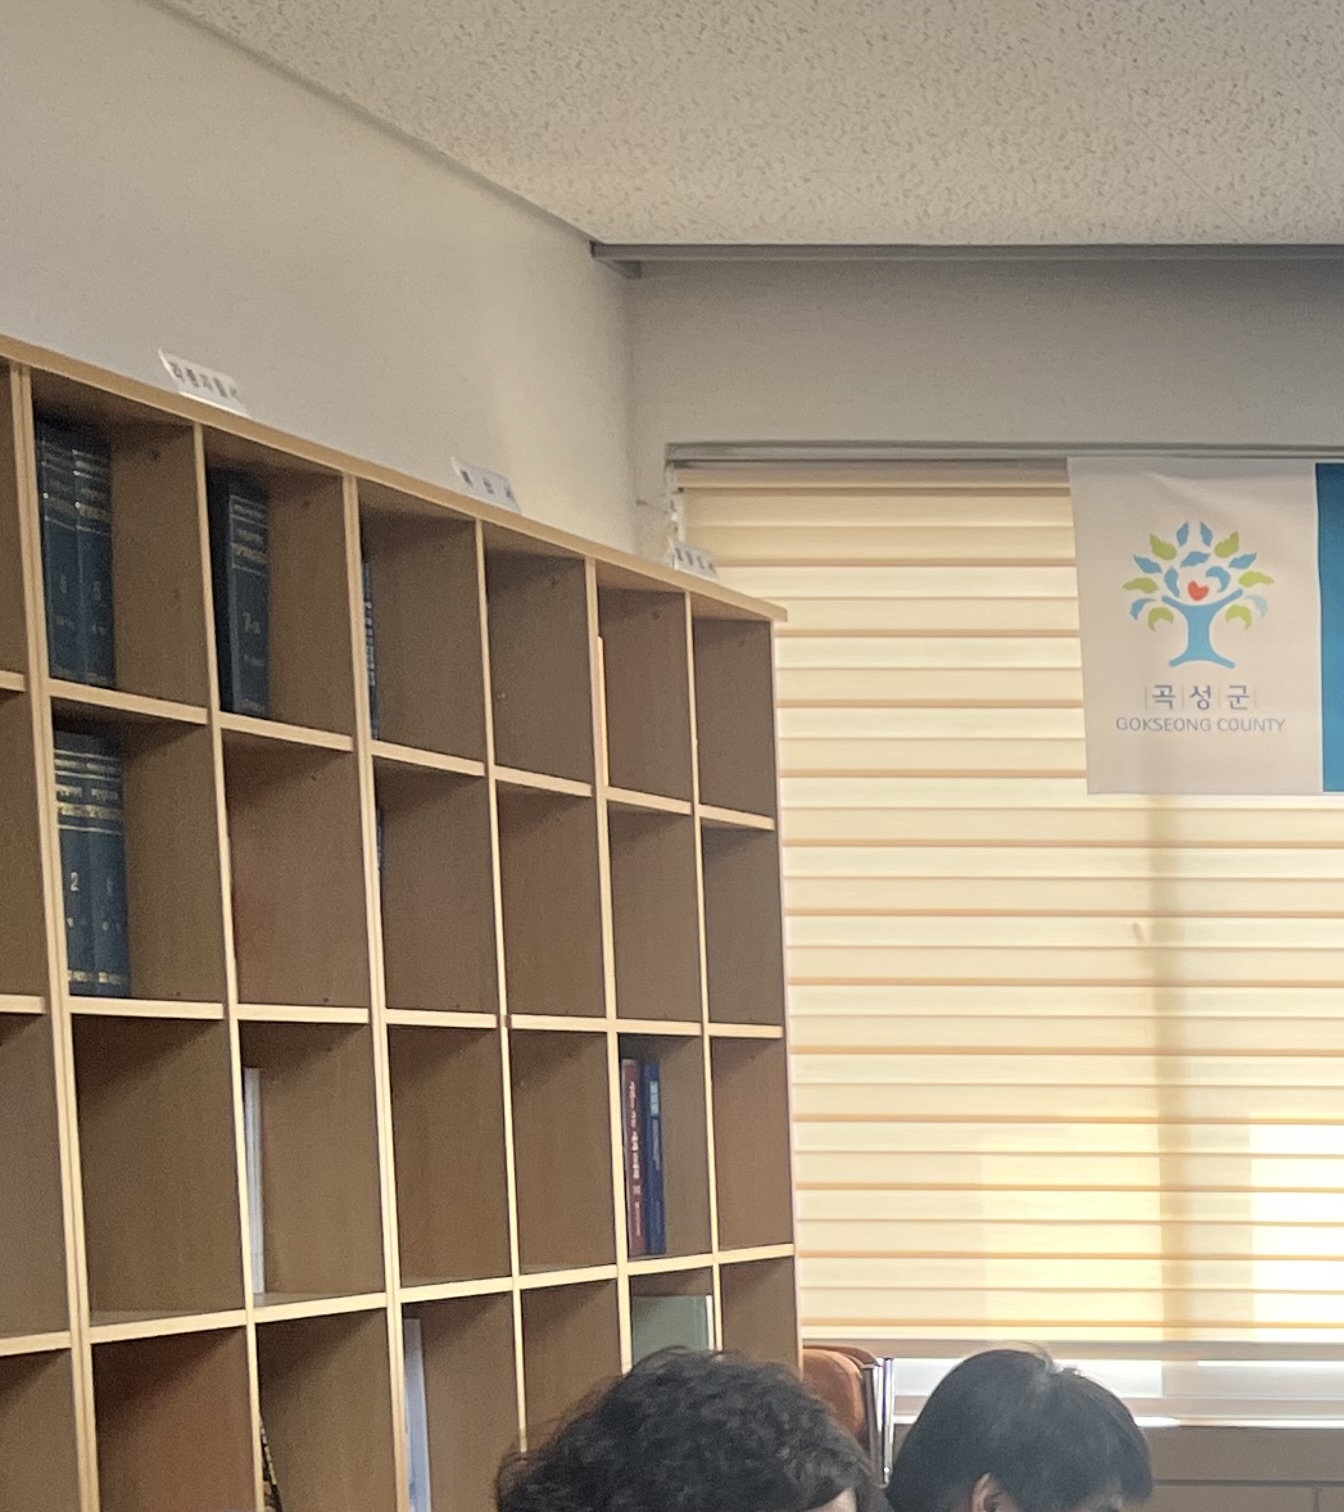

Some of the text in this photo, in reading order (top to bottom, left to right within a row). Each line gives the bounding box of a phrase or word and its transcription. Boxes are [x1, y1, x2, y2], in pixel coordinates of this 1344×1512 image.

[1152, 684, 1250, 710] 곡성군
[1115, 717, 1286, 732] GOKSEONG COUNTY
